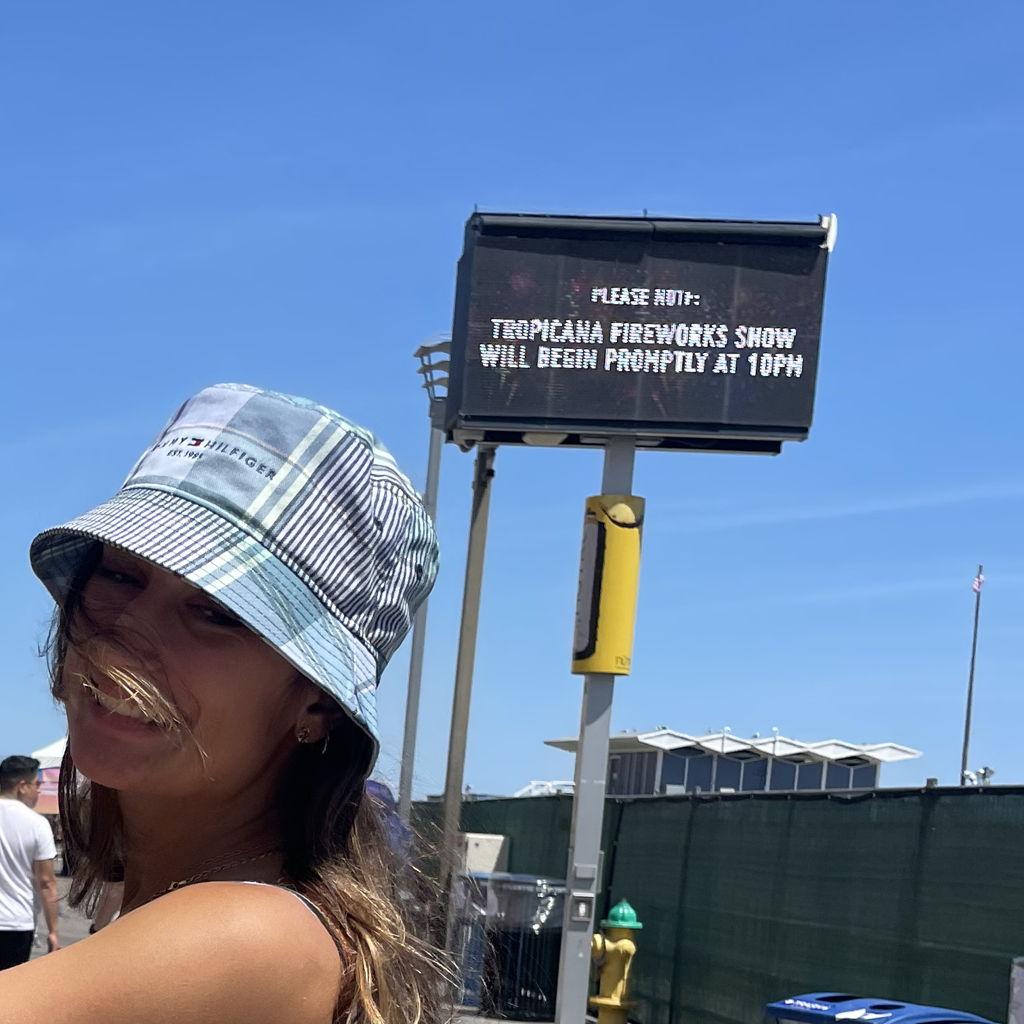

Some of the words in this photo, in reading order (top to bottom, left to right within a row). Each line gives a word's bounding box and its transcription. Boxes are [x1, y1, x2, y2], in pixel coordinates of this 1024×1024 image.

[591, 287, 650, 306] PLEASE
[491, 318, 604, 344] TROPICANA
[609, 322, 728, 348] FIREWORKS
[734, 325, 797, 349] SHOW
[479, 343, 530, 368] WILL
[537, 346, 598, 369] BEGIN
[604, 348, 709, 373] PROMPTLY
[712, 353, 741, 374] AT
[748, 352, 804, 378] 10PM
[204, 440, 276, 480] HILFIGER
